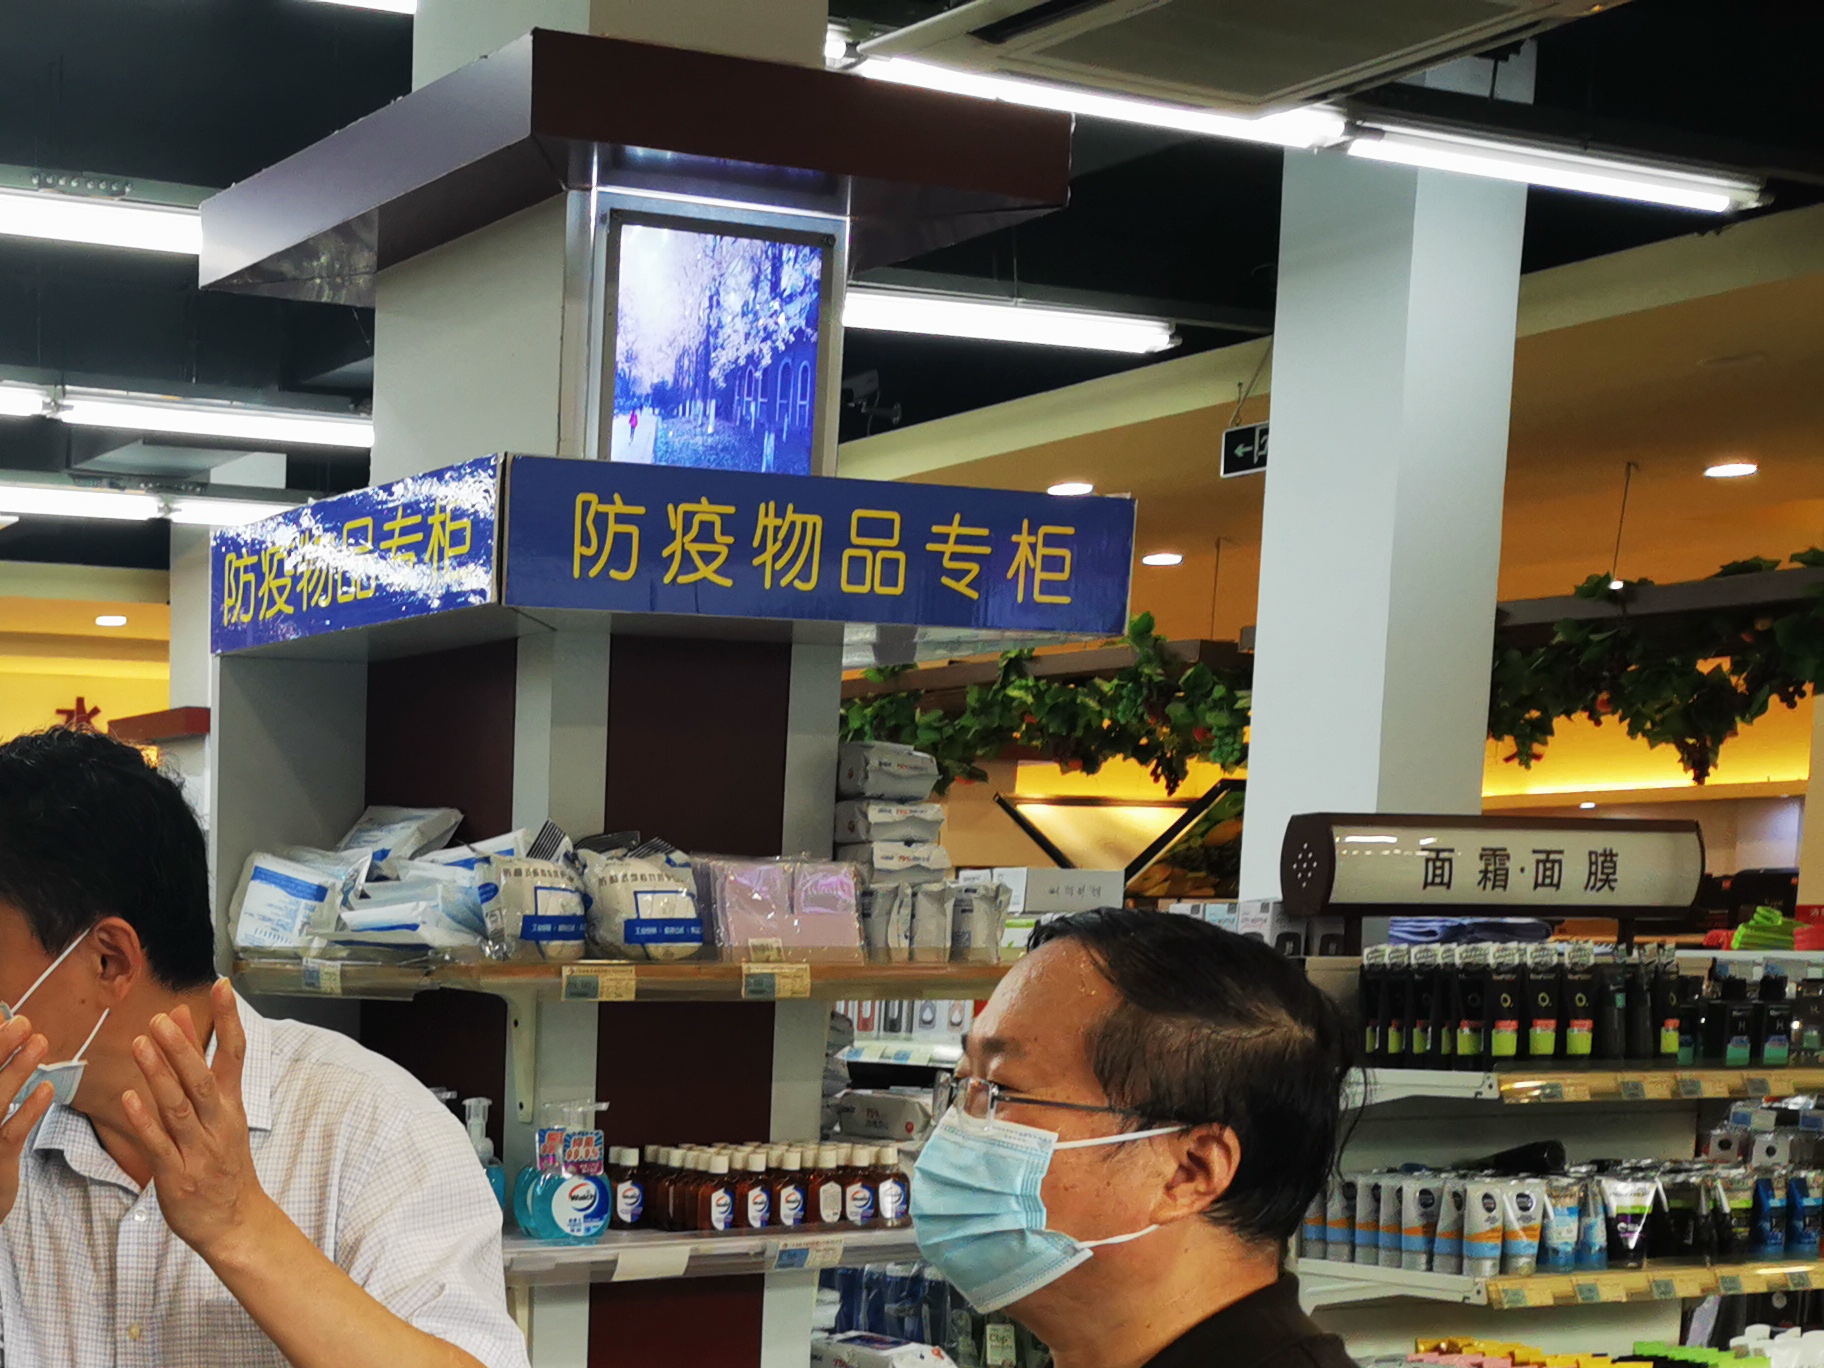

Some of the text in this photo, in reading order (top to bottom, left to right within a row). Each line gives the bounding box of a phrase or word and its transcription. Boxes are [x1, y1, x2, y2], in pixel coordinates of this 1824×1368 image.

[222, 501, 474, 628] 防疫物品专柜
[573, 491, 1077, 605] 防疫物品专柜
[1421, 846, 1620, 893] 面霜·面膜
